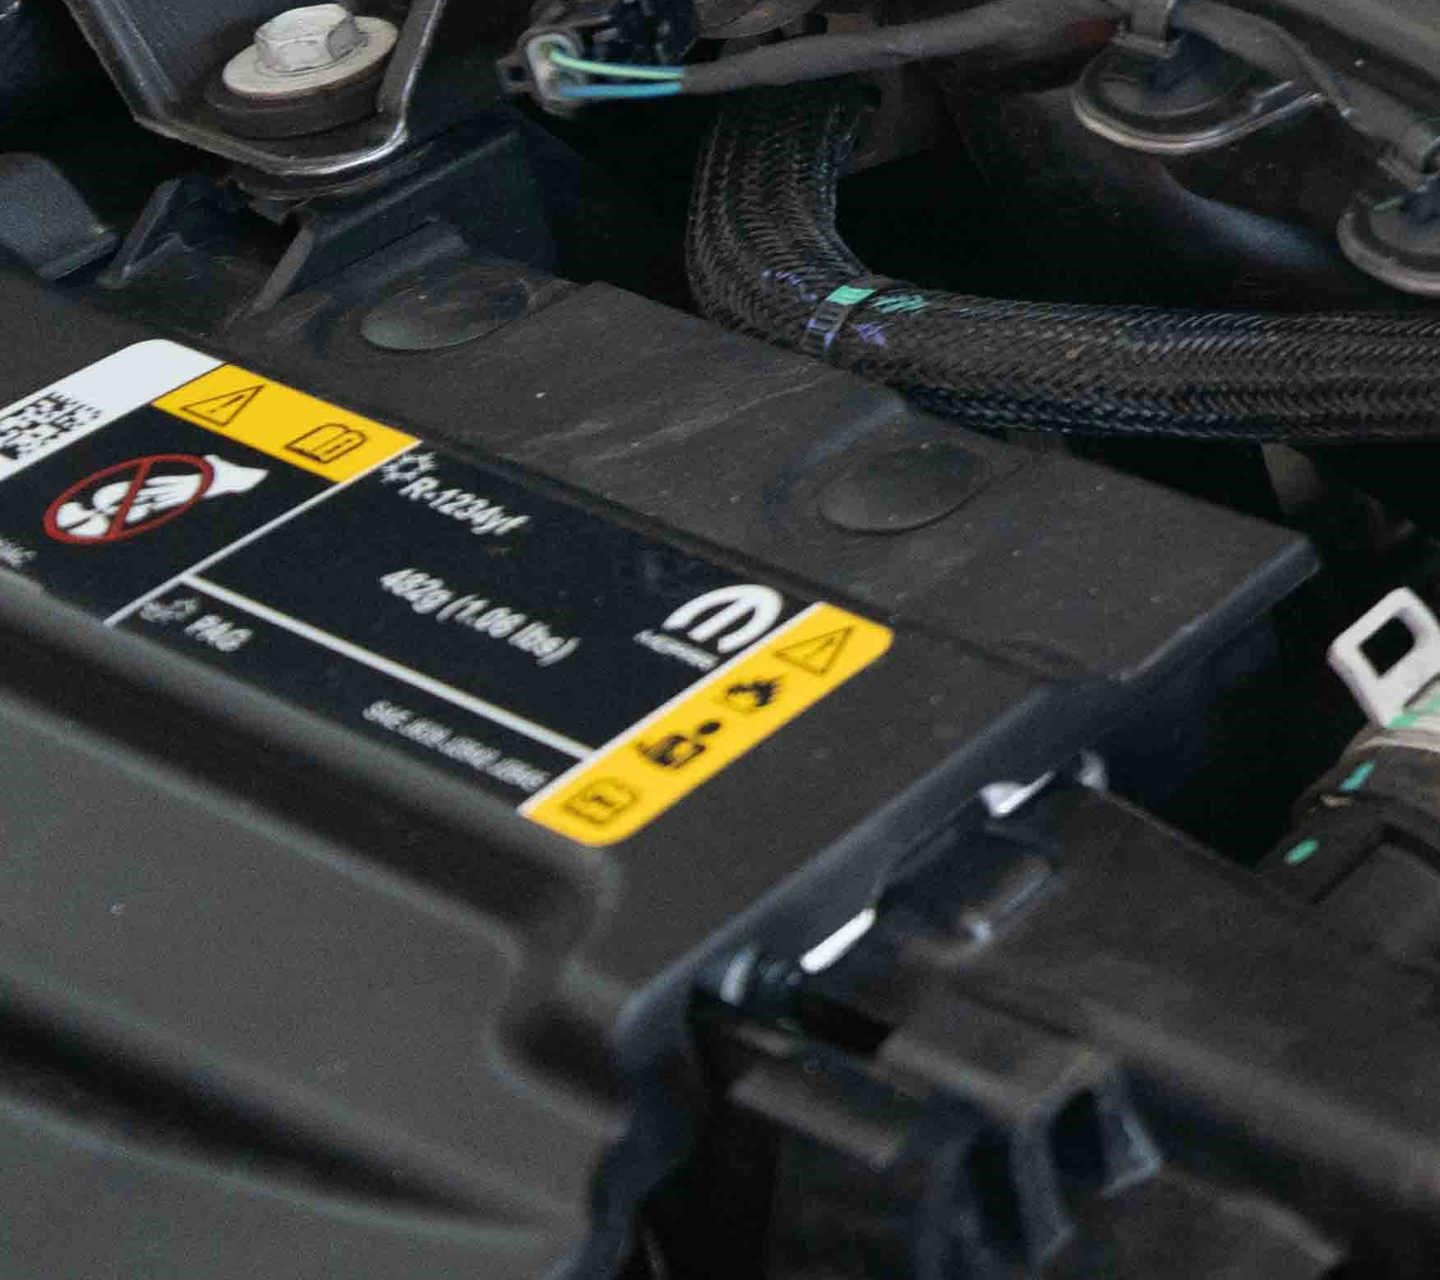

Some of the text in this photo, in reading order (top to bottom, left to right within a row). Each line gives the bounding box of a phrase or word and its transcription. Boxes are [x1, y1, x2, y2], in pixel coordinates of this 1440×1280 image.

[398, 476, 531, 536] R-1234yf
[184, 613, 253, 653] PAG
[507, 620, 582, 669] lbs)
